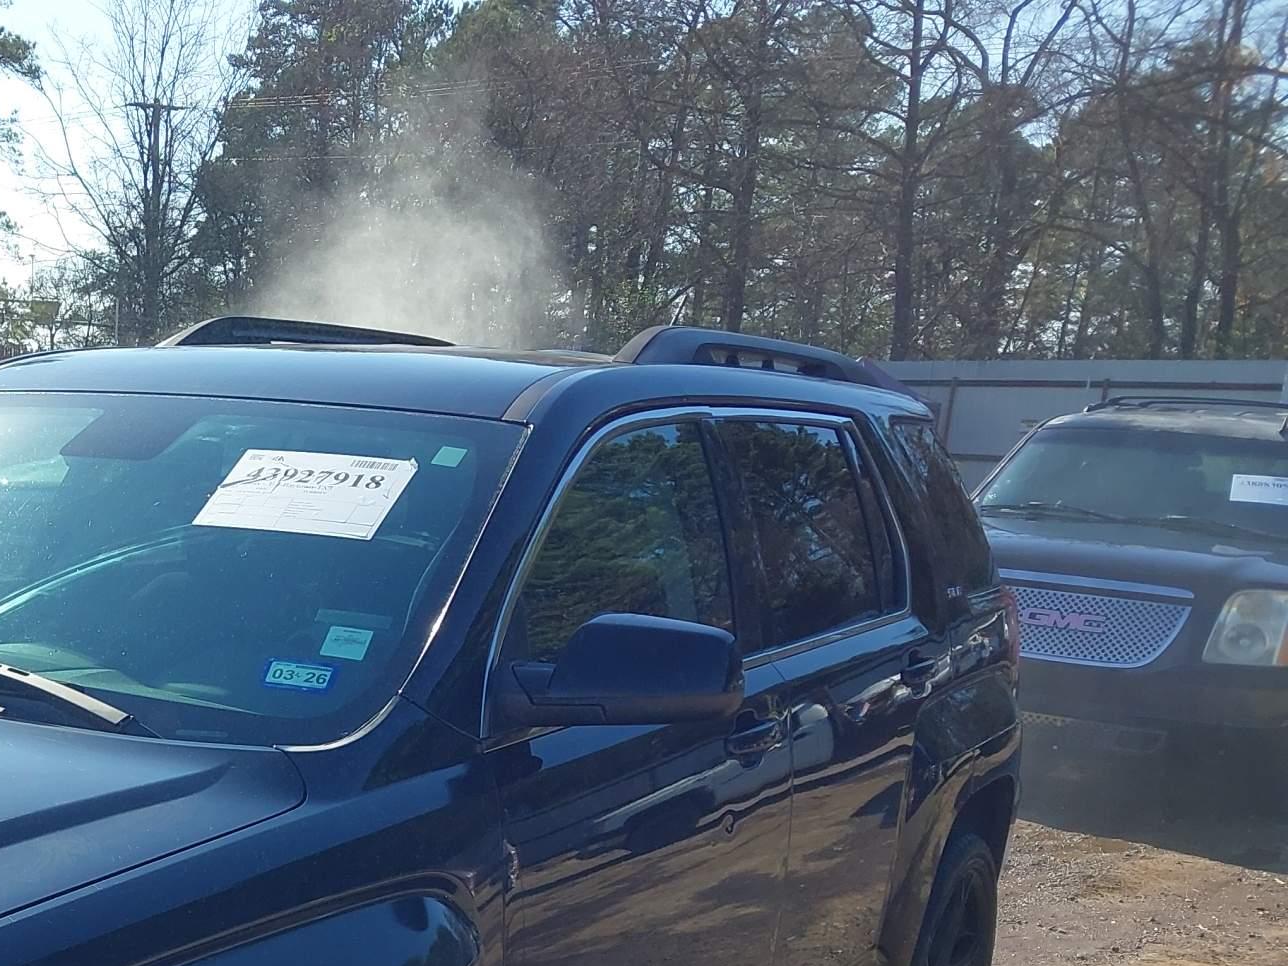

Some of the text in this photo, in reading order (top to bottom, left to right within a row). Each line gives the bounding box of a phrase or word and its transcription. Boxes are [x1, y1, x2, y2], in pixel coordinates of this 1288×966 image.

[246, 467, 385, 490] 43927918
[1021, 607, 1106, 634] GMC
[271, 668, 328, 685] 03 26
